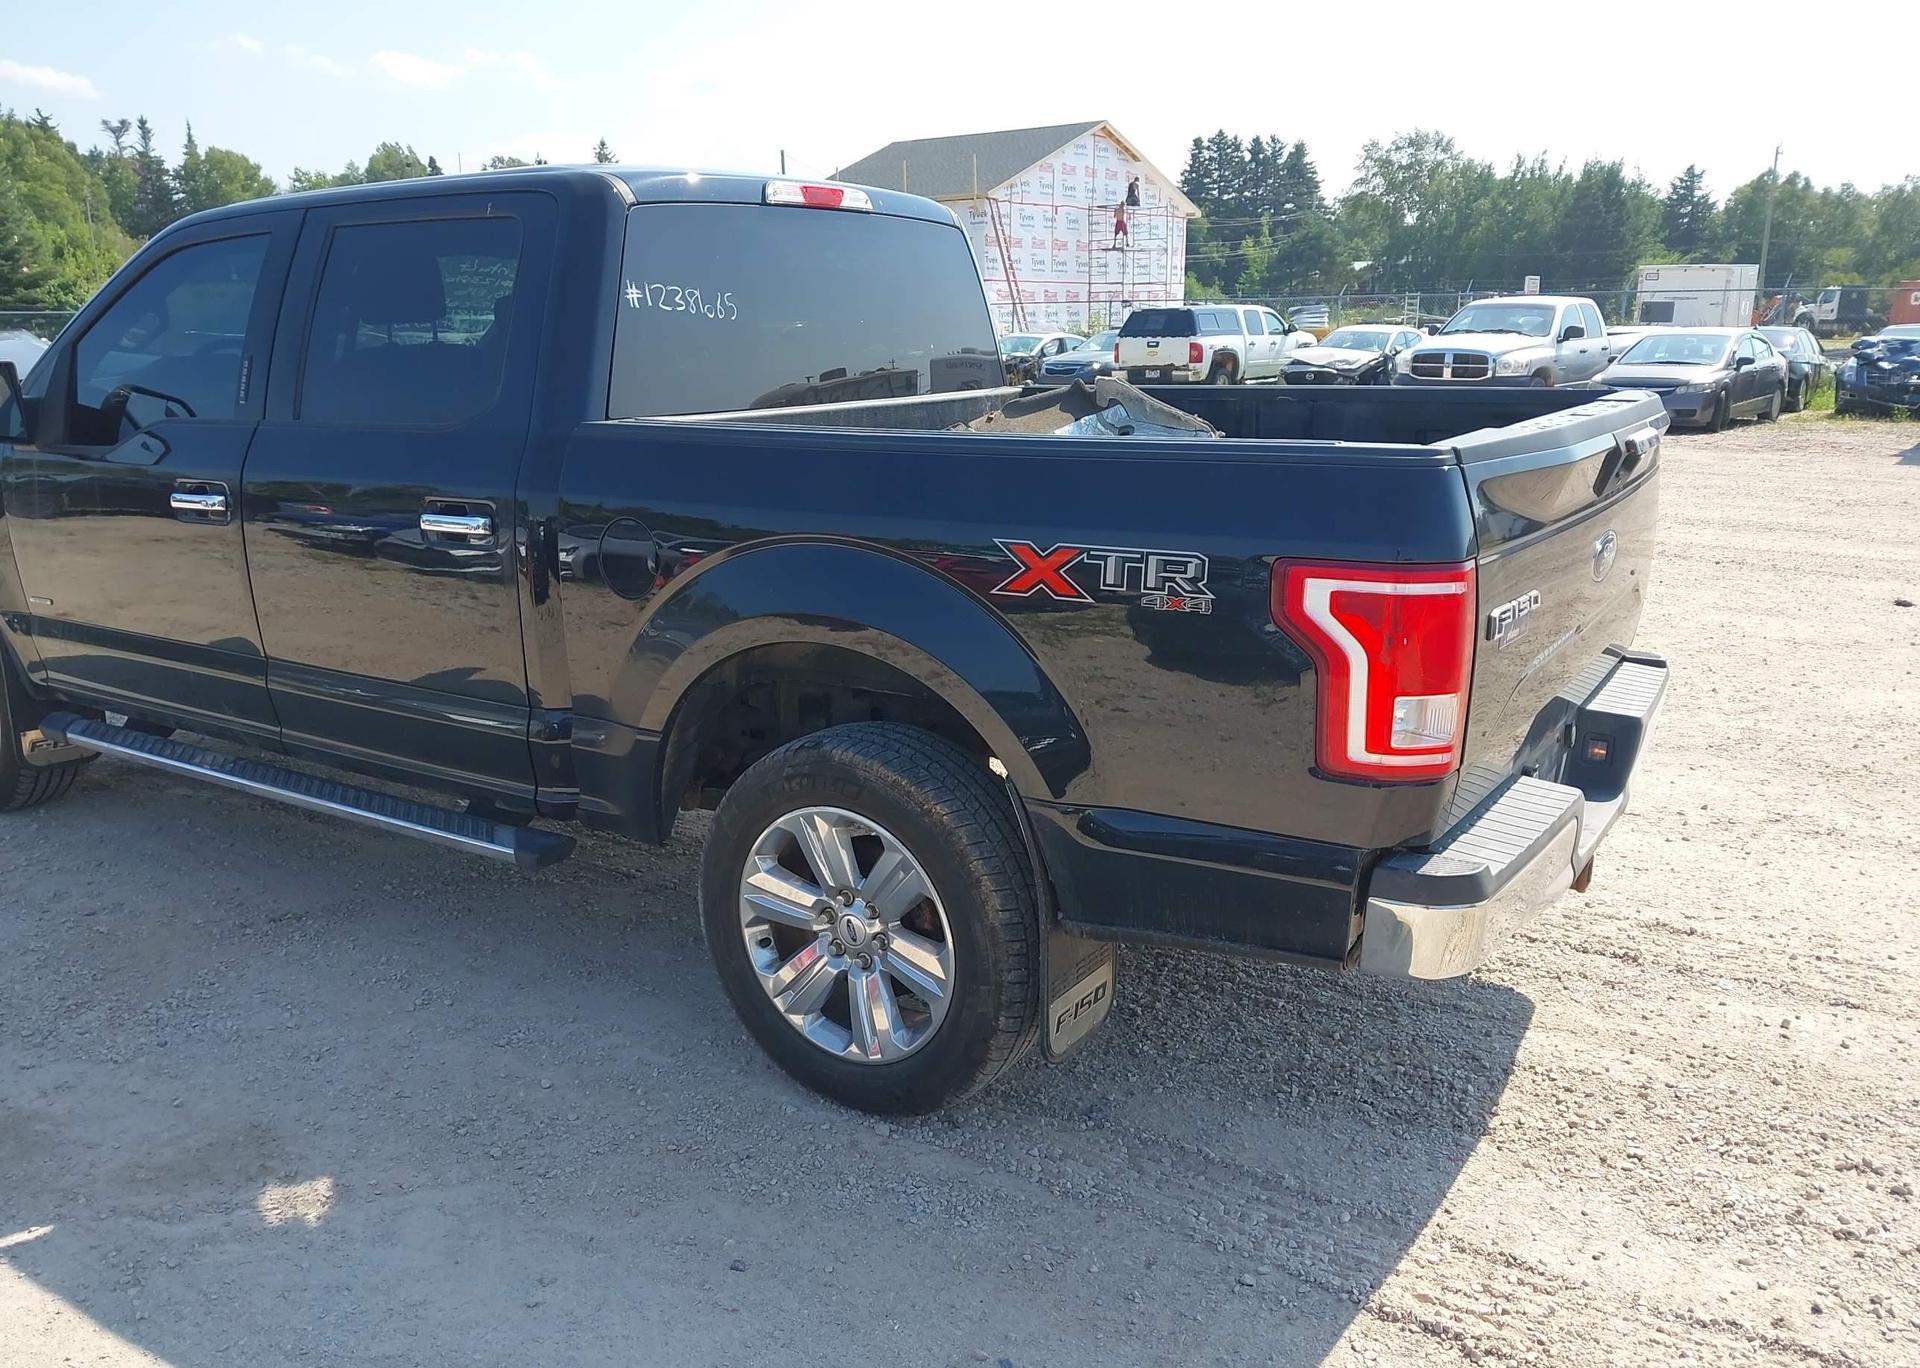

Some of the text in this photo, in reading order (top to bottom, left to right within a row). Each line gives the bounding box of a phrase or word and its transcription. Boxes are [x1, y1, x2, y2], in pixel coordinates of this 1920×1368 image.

[969, 210, 988, 220] Tyvek
[989, 538, 1216, 604] XTR
[1054, 980, 1108, 1036] F-150
